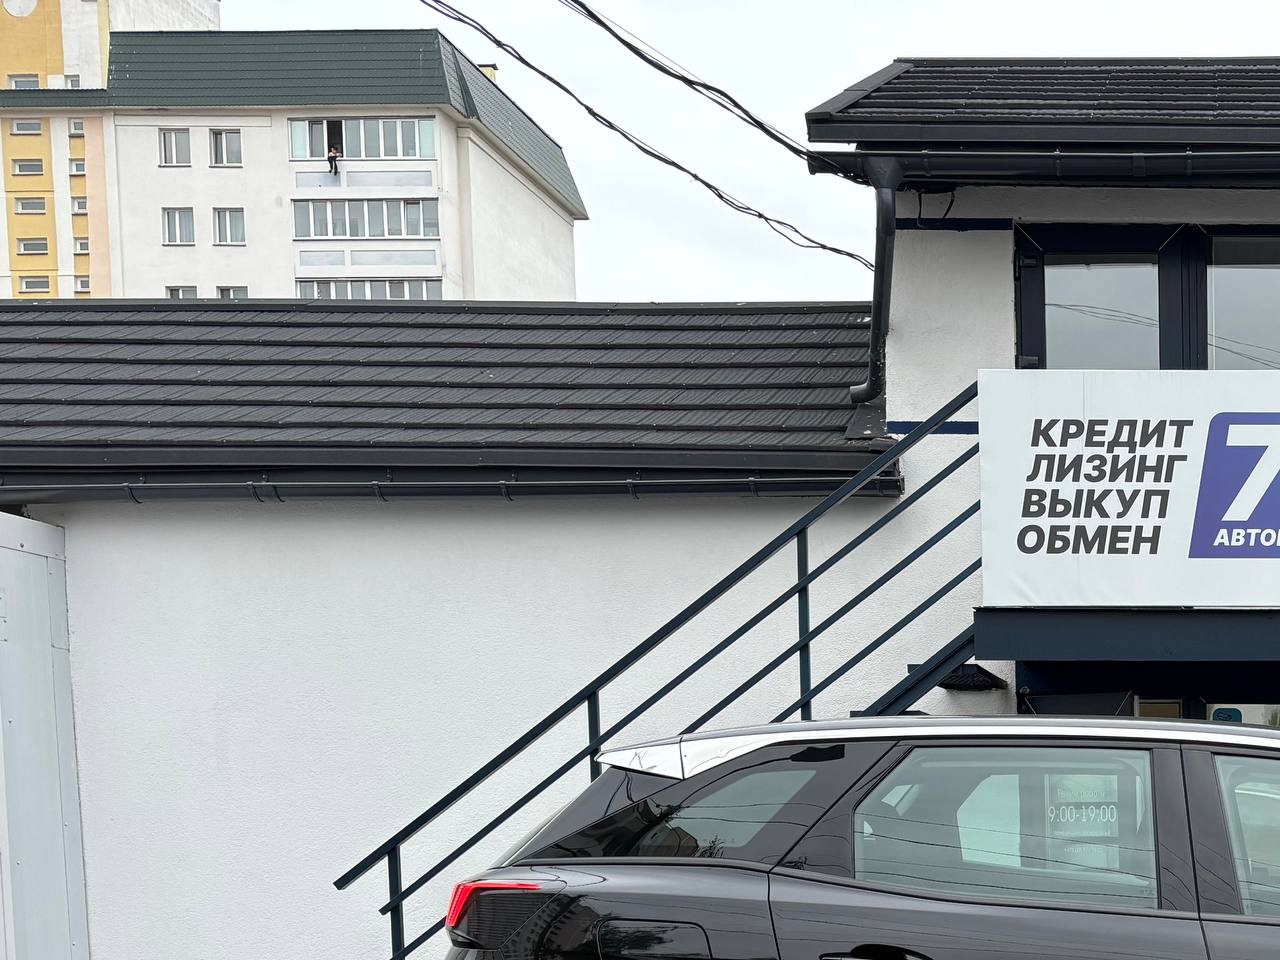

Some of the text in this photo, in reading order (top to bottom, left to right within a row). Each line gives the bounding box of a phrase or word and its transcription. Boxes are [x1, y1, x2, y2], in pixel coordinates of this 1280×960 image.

[1030, 418, 1194, 454] КРЕДИТ
[1025, 453, 1188, 483] ЛИЗИНГ
[1020, 488, 1170, 519] ВЫКУП
[1016, 524, 1162, 555] ОБМЕН
[1048, 805, 1117, 822] 9:00-19:00
